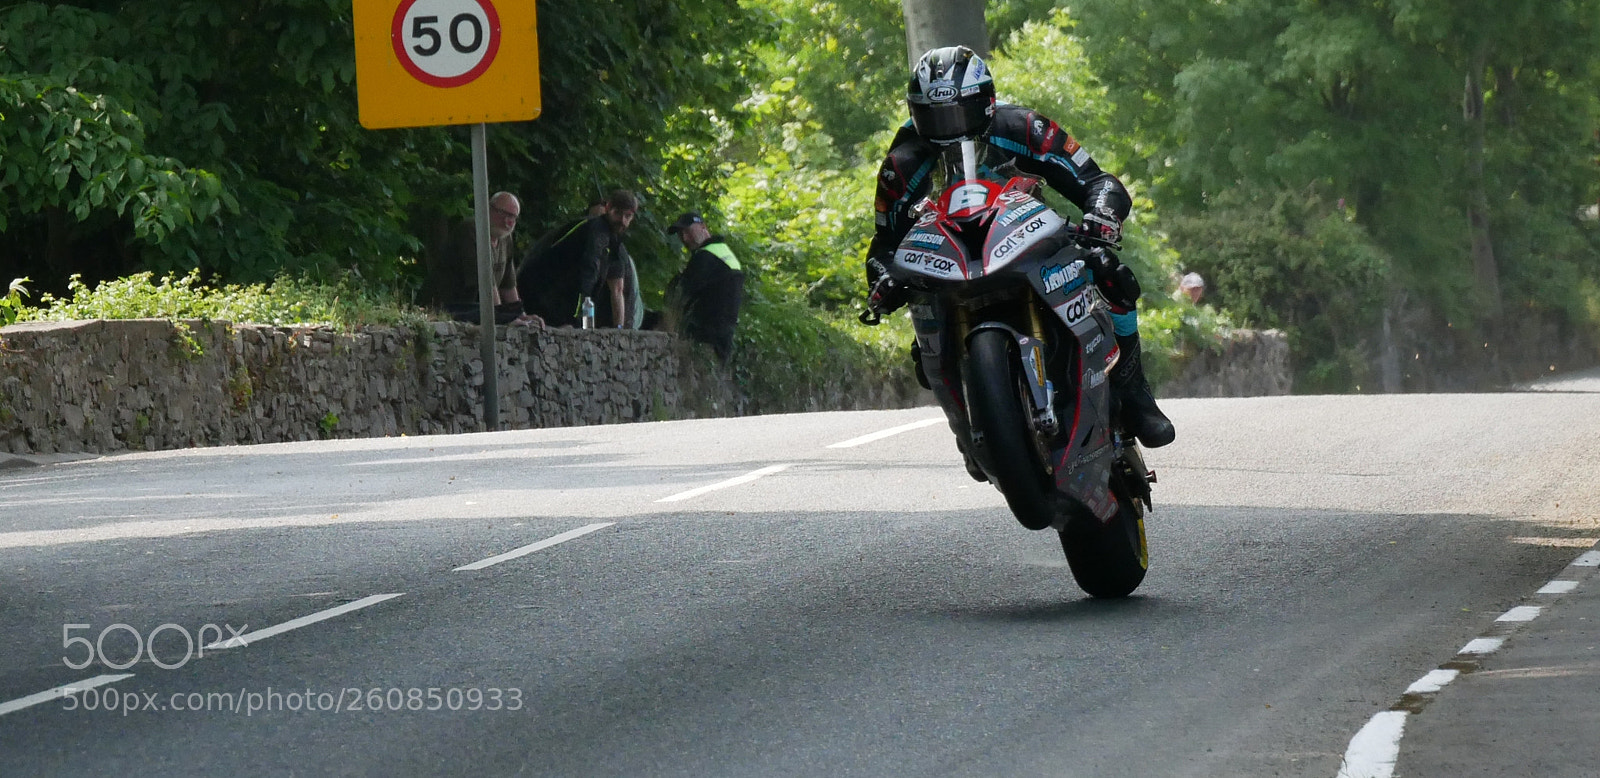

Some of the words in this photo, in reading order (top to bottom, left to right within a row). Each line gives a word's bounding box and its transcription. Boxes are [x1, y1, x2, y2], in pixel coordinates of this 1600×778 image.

[412, 13, 483, 56] 50
[931, 87, 954, 98] Arai
[947, 184, 989, 216] 6
[994, 237, 1018, 258] carl
[1025, 217, 1047, 233] cox
[904, 252, 924, 265] carl
[933, 258, 955, 272] cox
